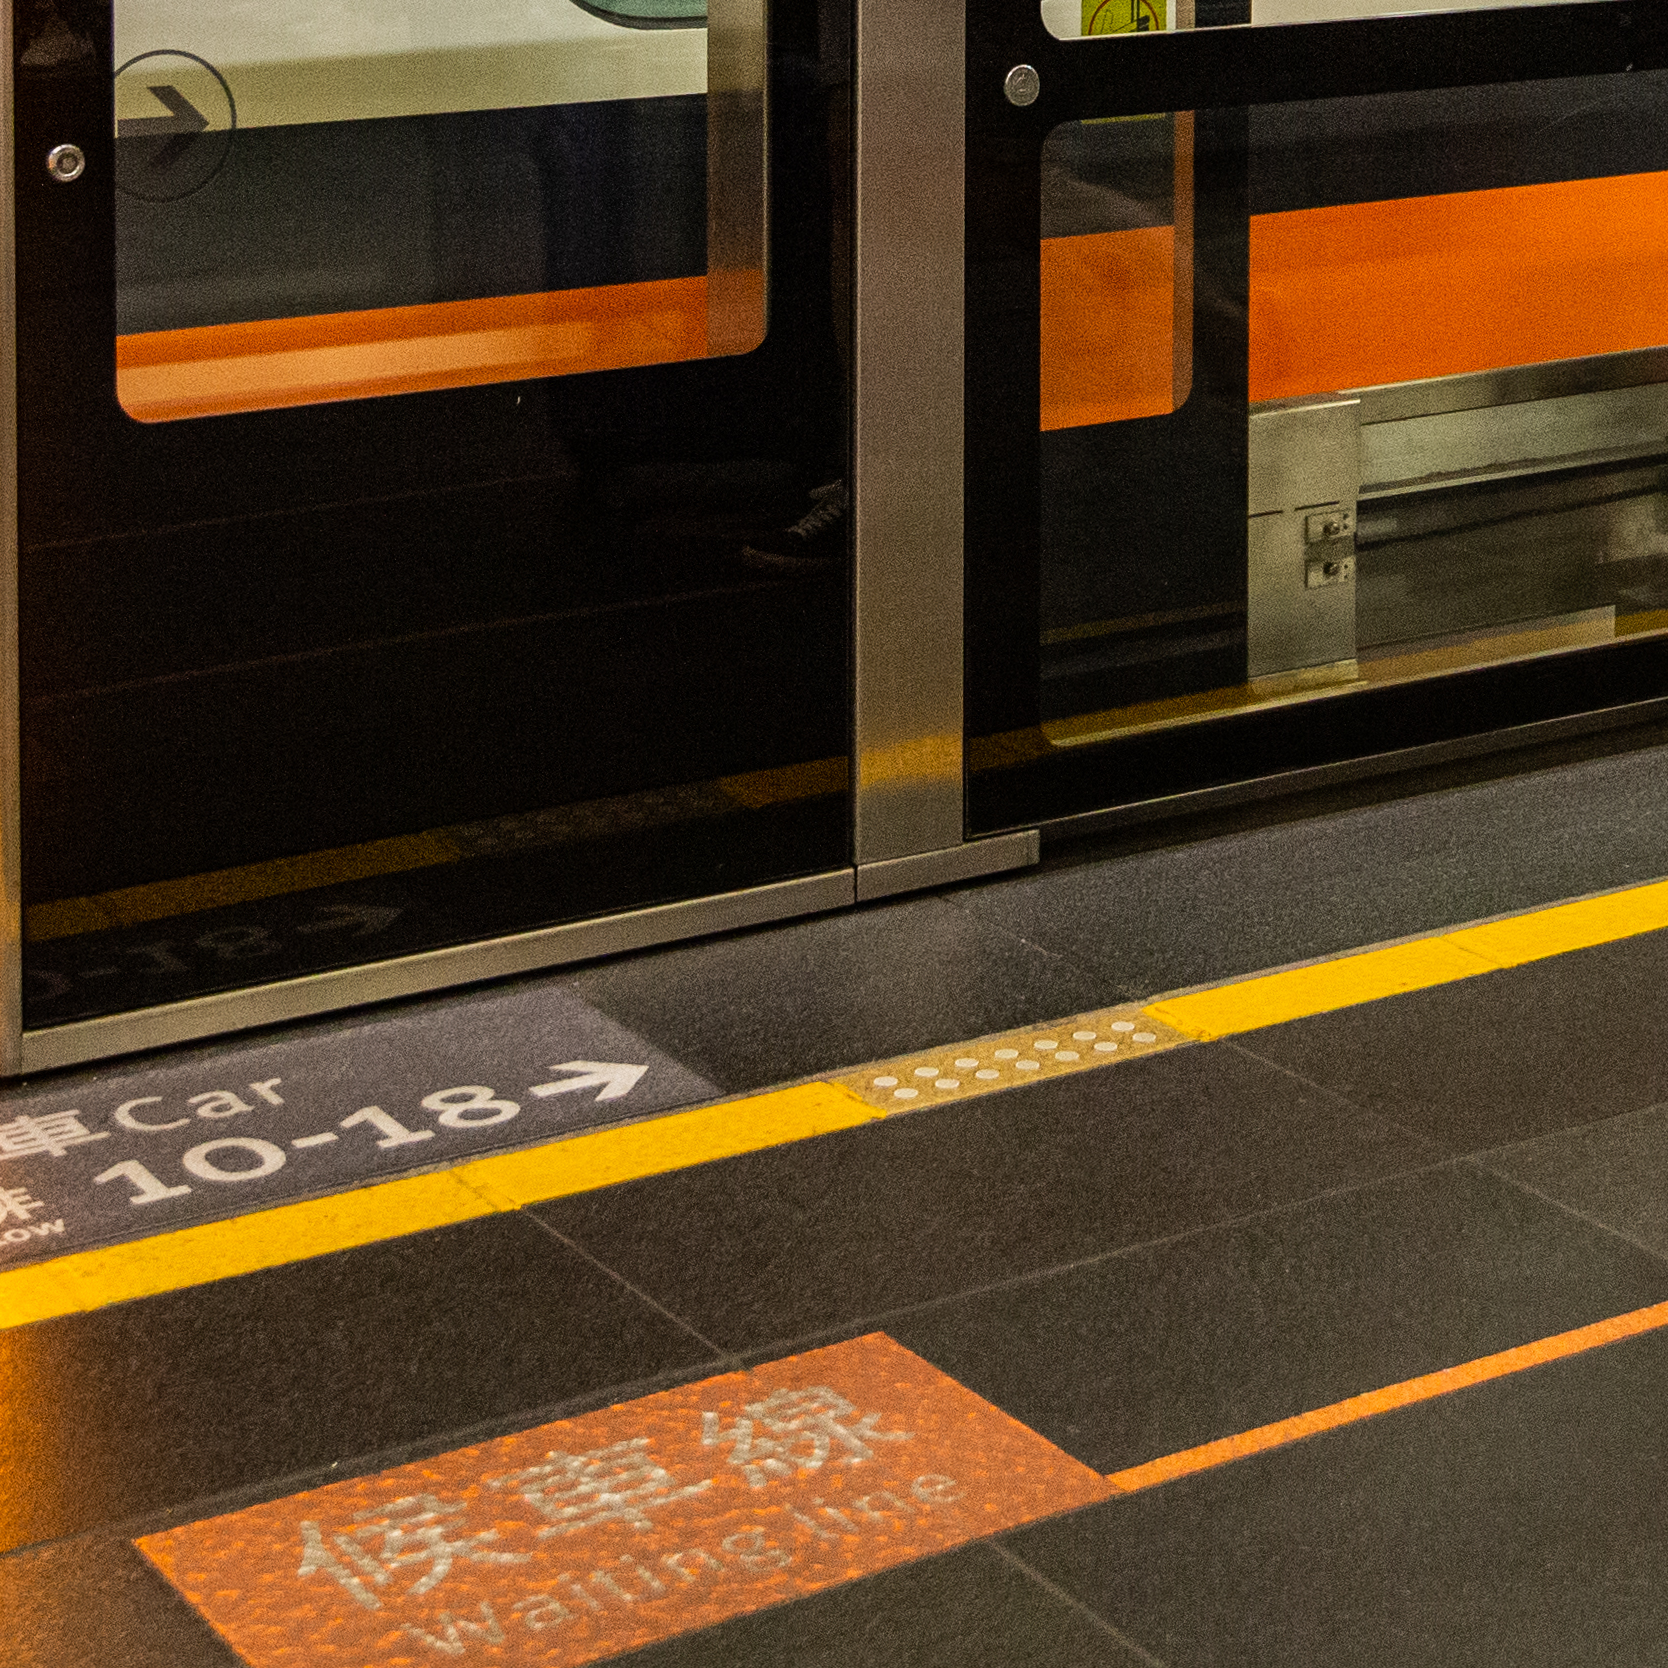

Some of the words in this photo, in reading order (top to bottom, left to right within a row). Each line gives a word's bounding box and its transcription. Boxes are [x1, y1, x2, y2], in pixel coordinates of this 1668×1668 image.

[92, 1084, 524, 1208] 10-18
[108, 1077, 285, 1134] Car
[296, 1382, 917, 1612] 候車線
[400, 1522, 798, 1658] Waiting
[782, 1468, 966, 1545] line
